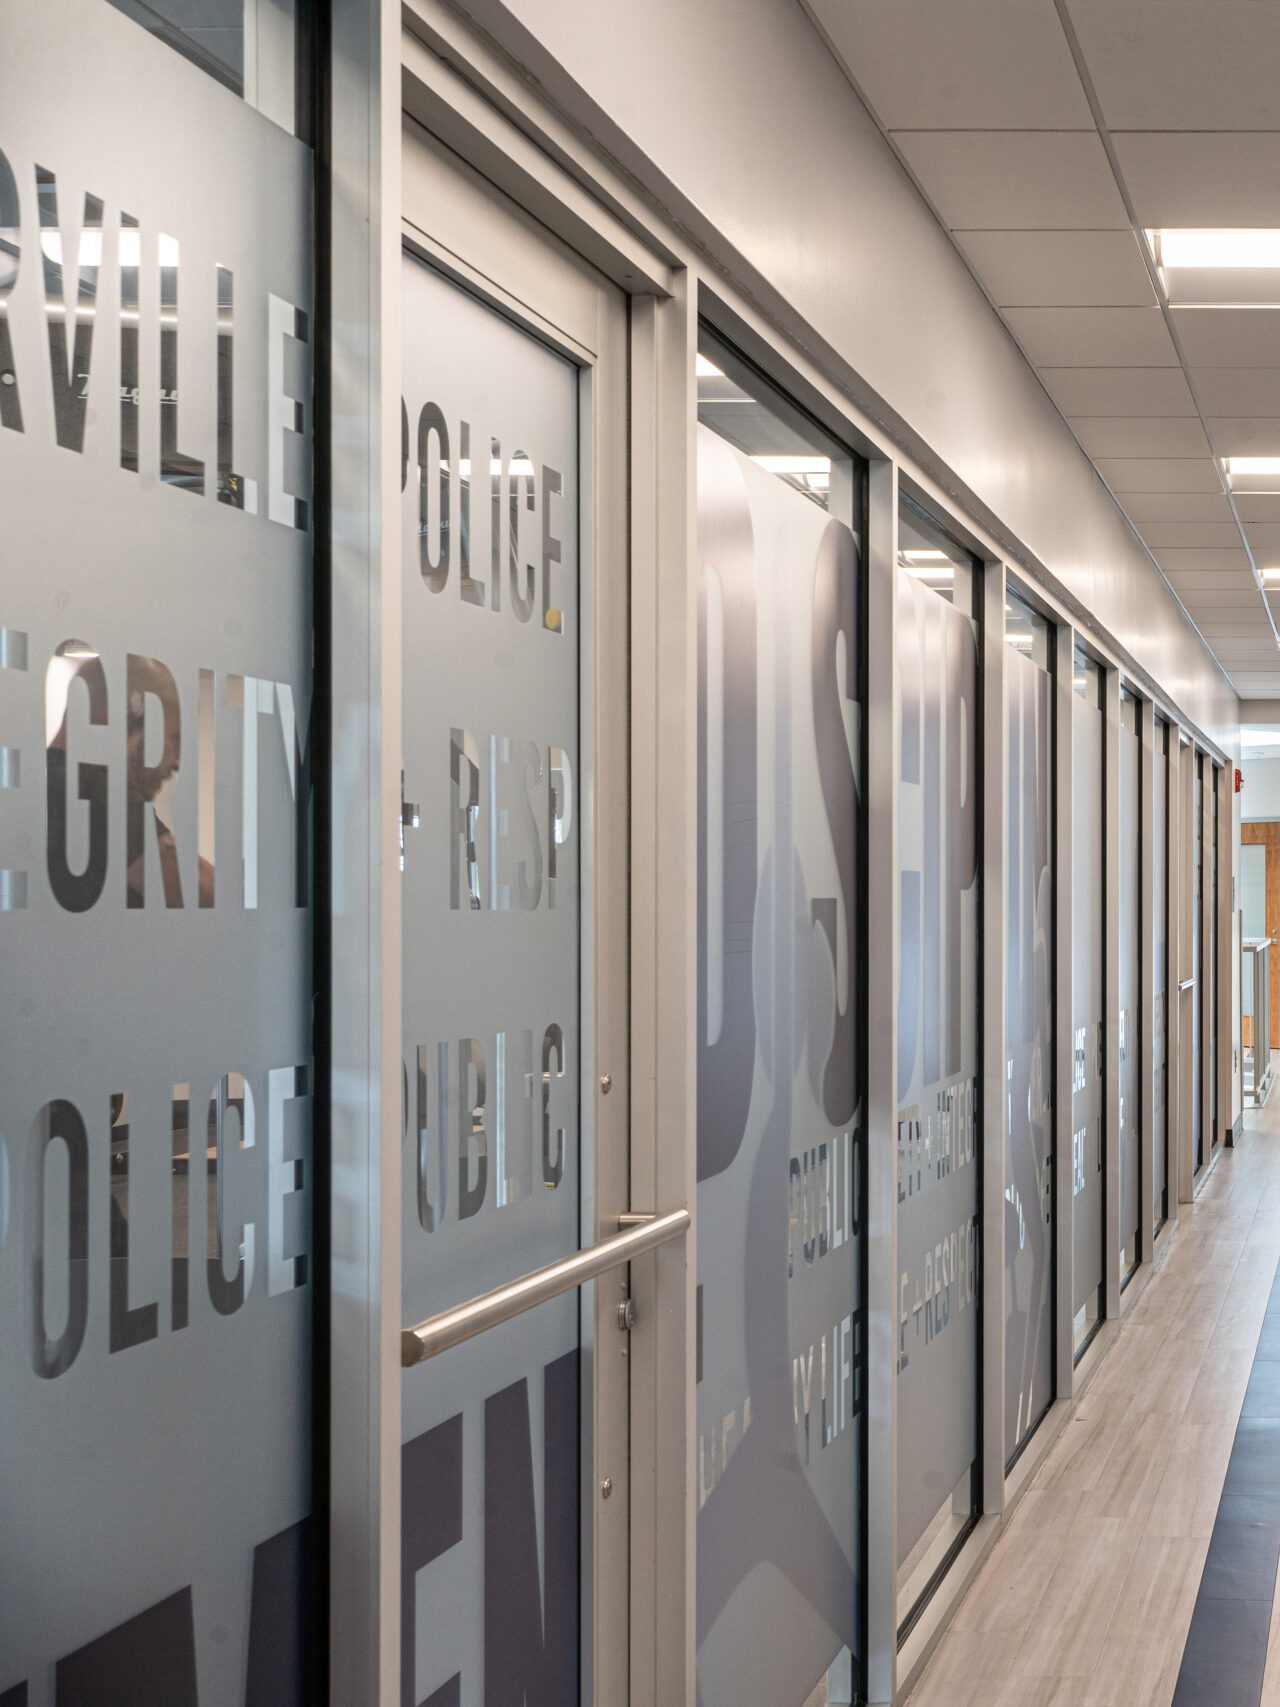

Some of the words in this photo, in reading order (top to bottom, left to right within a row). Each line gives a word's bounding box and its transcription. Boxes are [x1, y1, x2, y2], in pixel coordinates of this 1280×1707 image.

[401, 394, 564, 636] OLICE
[0, 1064, 309, 1380] OLICE
[402, 1022, 567, 1234] UBLIC
